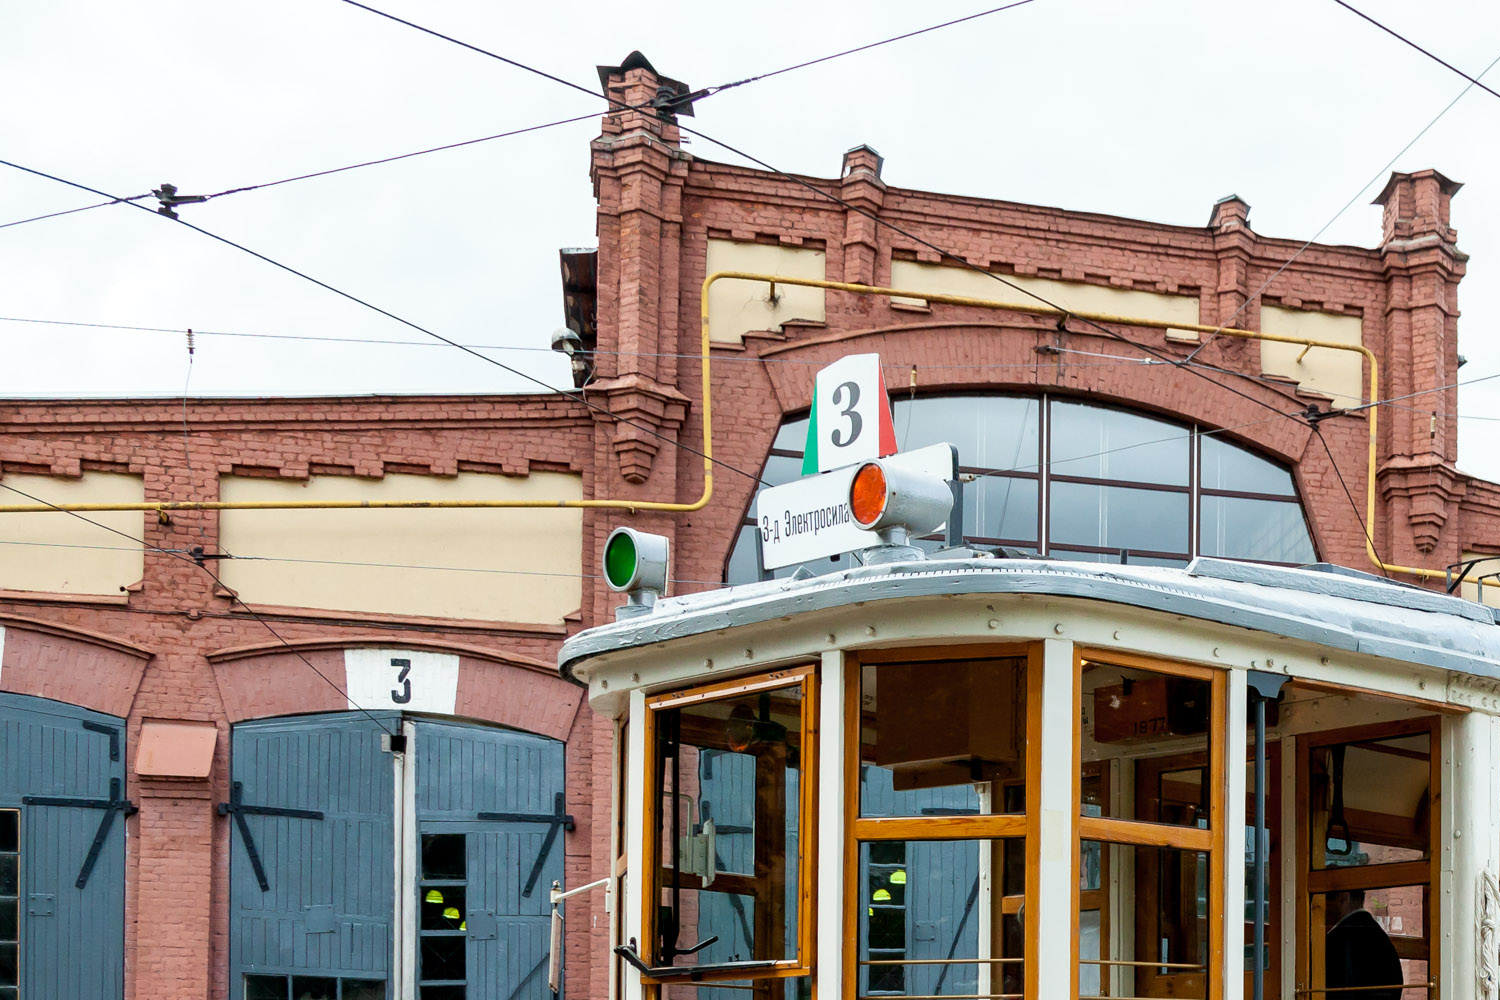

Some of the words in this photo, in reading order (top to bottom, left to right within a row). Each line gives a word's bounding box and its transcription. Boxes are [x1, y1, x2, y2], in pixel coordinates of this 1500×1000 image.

[831, 381, 863, 448] 3
[784, 502, 850, 537] Электросила
[390, 658, 412, 704] 3
